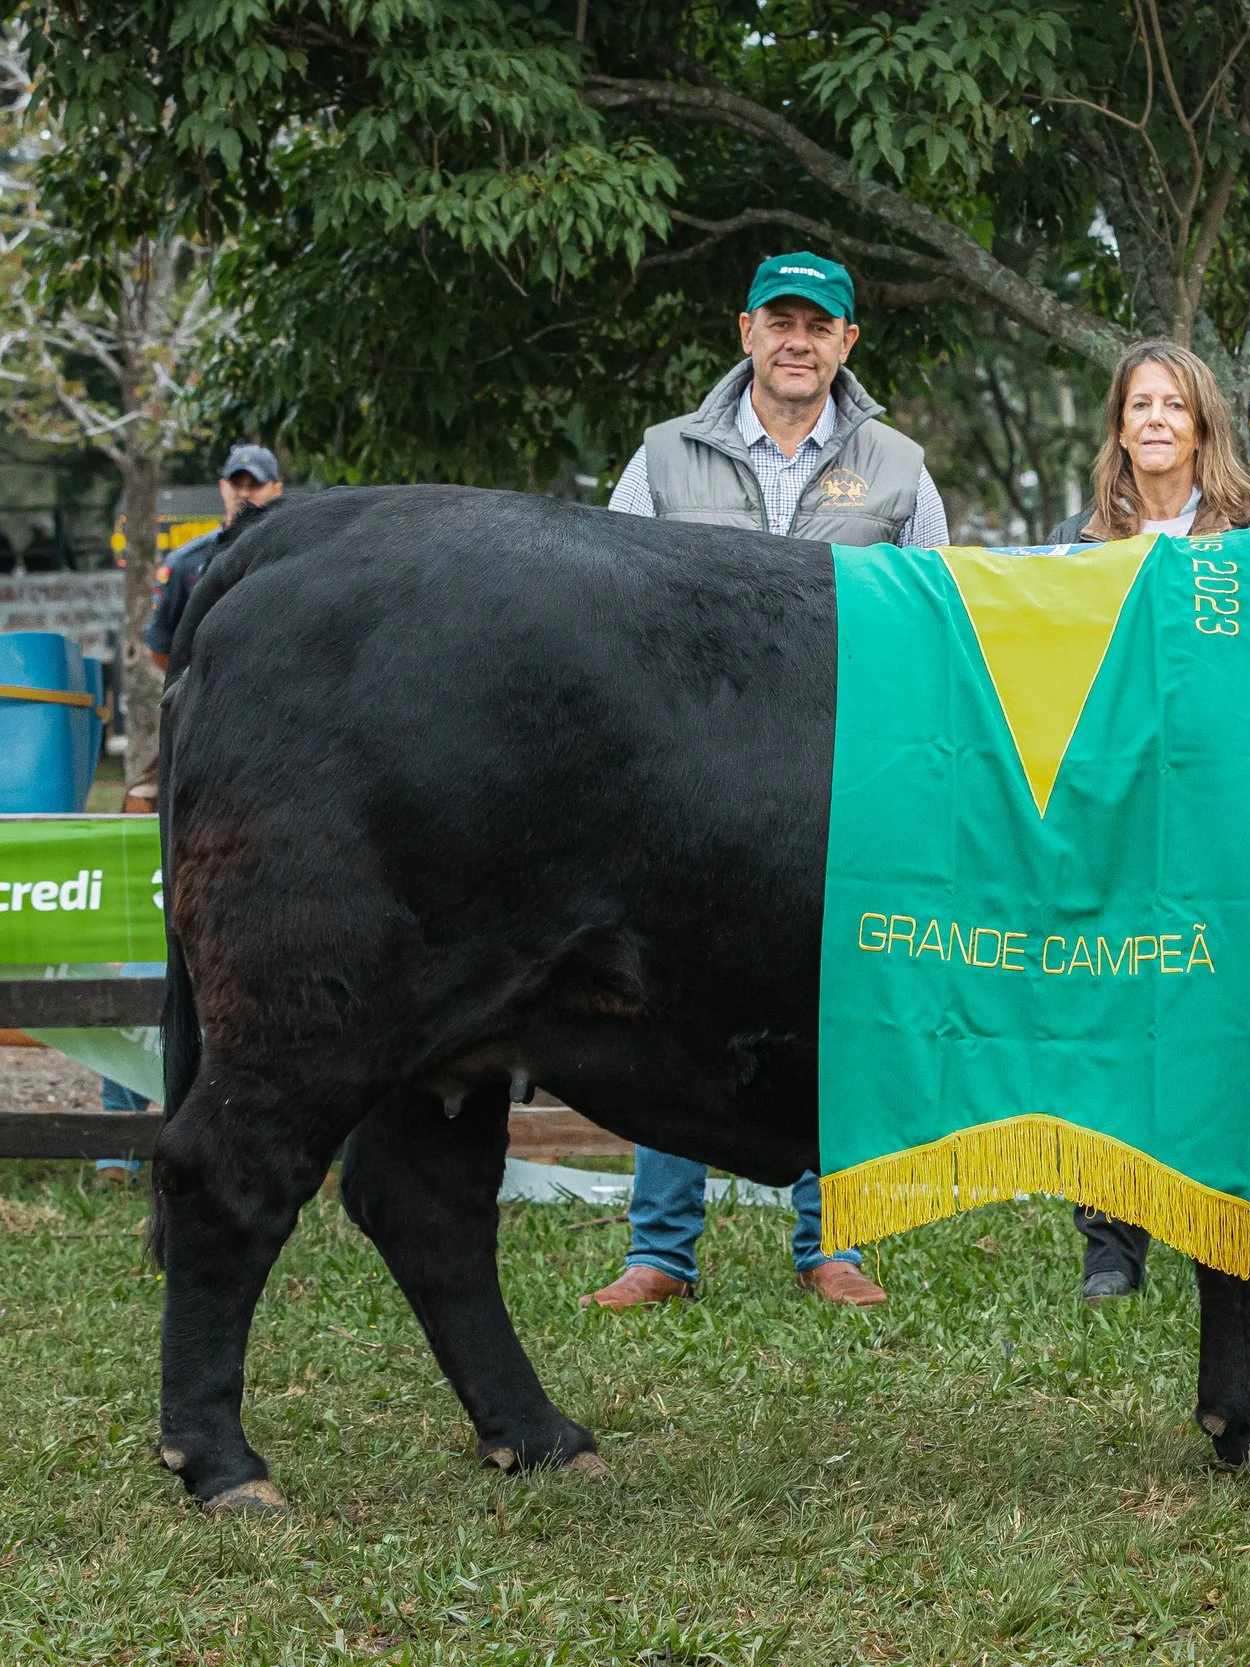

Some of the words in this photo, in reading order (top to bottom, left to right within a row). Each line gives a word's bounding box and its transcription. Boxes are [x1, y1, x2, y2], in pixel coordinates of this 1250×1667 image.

[1192, 558, 1240, 636] 2023
[858, 912, 1028, 971] GRANDE
[1042, 923, 1216, 976] CAMPEÃ
